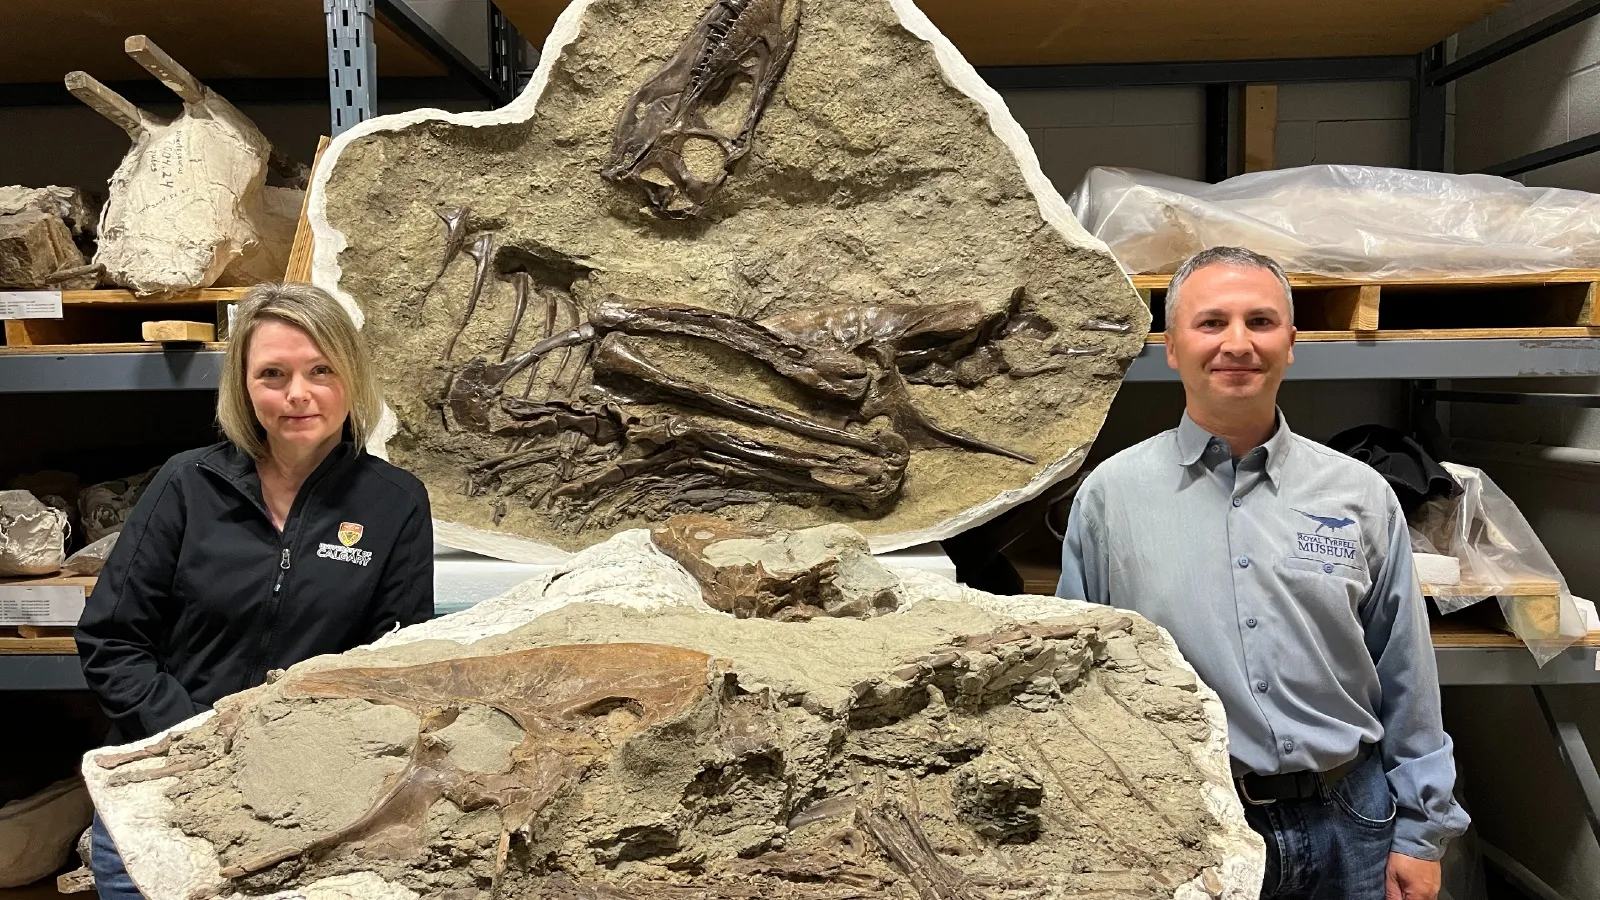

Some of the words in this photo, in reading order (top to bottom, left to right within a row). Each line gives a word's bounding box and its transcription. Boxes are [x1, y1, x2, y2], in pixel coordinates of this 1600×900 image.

[1297, 533, 1322, 544] ROYAL
[1325, 537, 1356, 549] TYRRELL
[316, 548, 371, 566] CALGARY
[1297, 541, 1356, 560] MUSEUM
